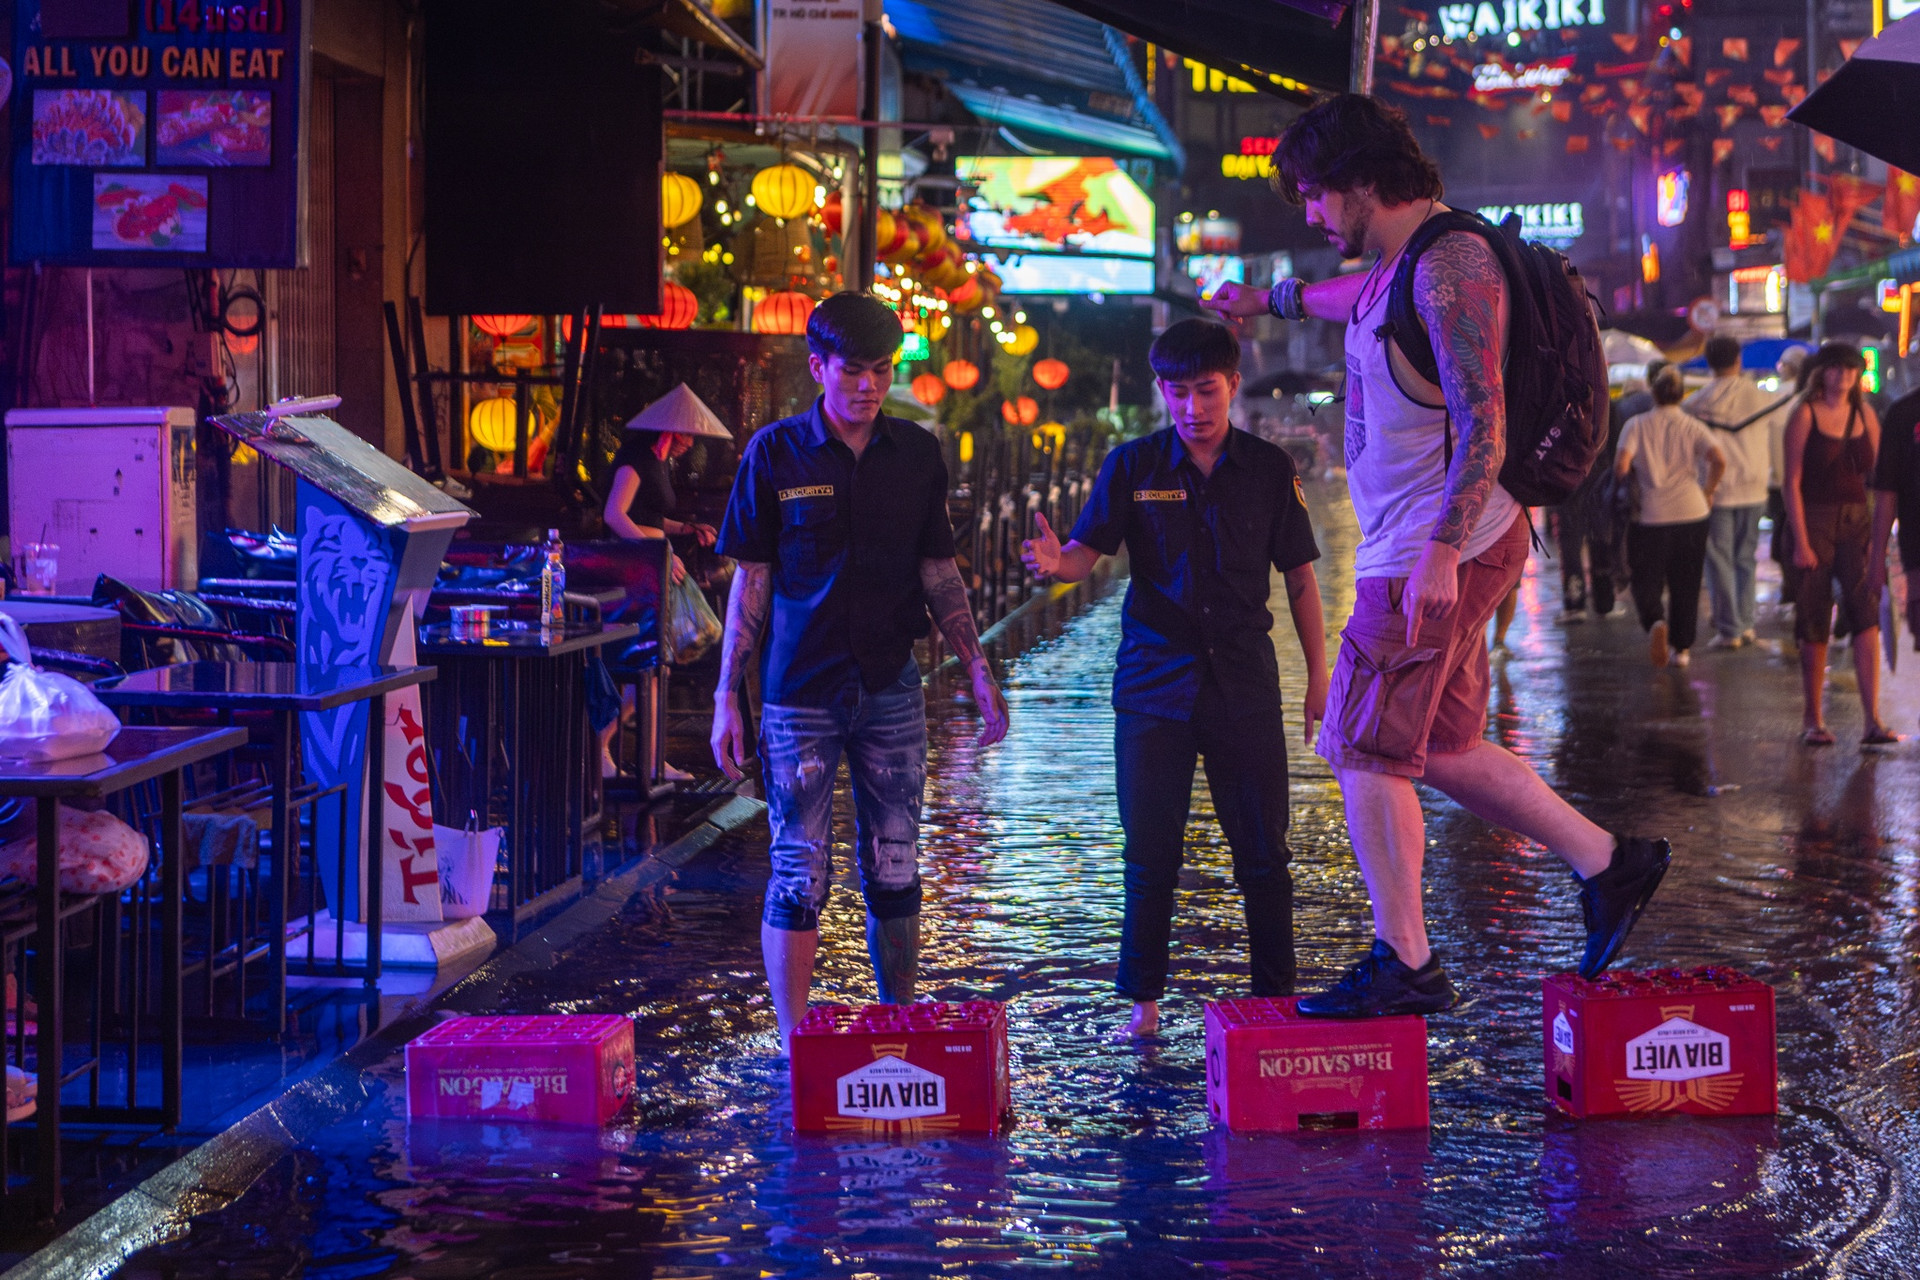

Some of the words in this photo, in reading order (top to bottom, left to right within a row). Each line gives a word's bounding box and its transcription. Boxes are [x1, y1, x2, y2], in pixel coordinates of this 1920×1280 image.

[1438, 0, 1605, 38] WAIKIKI
[24, 47, 77, 76] ALL
[91, 47, 149, 77] YOU
[162, 47, 220, 78] CAN
[230, 49, 284, 79] EAT
[787, 487, 824, 499] SECURITY
[1142, 490, 1179, 500] SECURITY
[1259, 1054, 1351, 1077] SAIGON
[1353, 1051, 1393, 1070] Bia
[1633, 1041, 1682, 1074] VIỆT
[1684, 1042, 1723, 1067] BIA
[530, 1075, 568, 1095] Bia
[844, 1079, 895, 1112] VIỆT
[897, 1082, 938, 1107] BIA
